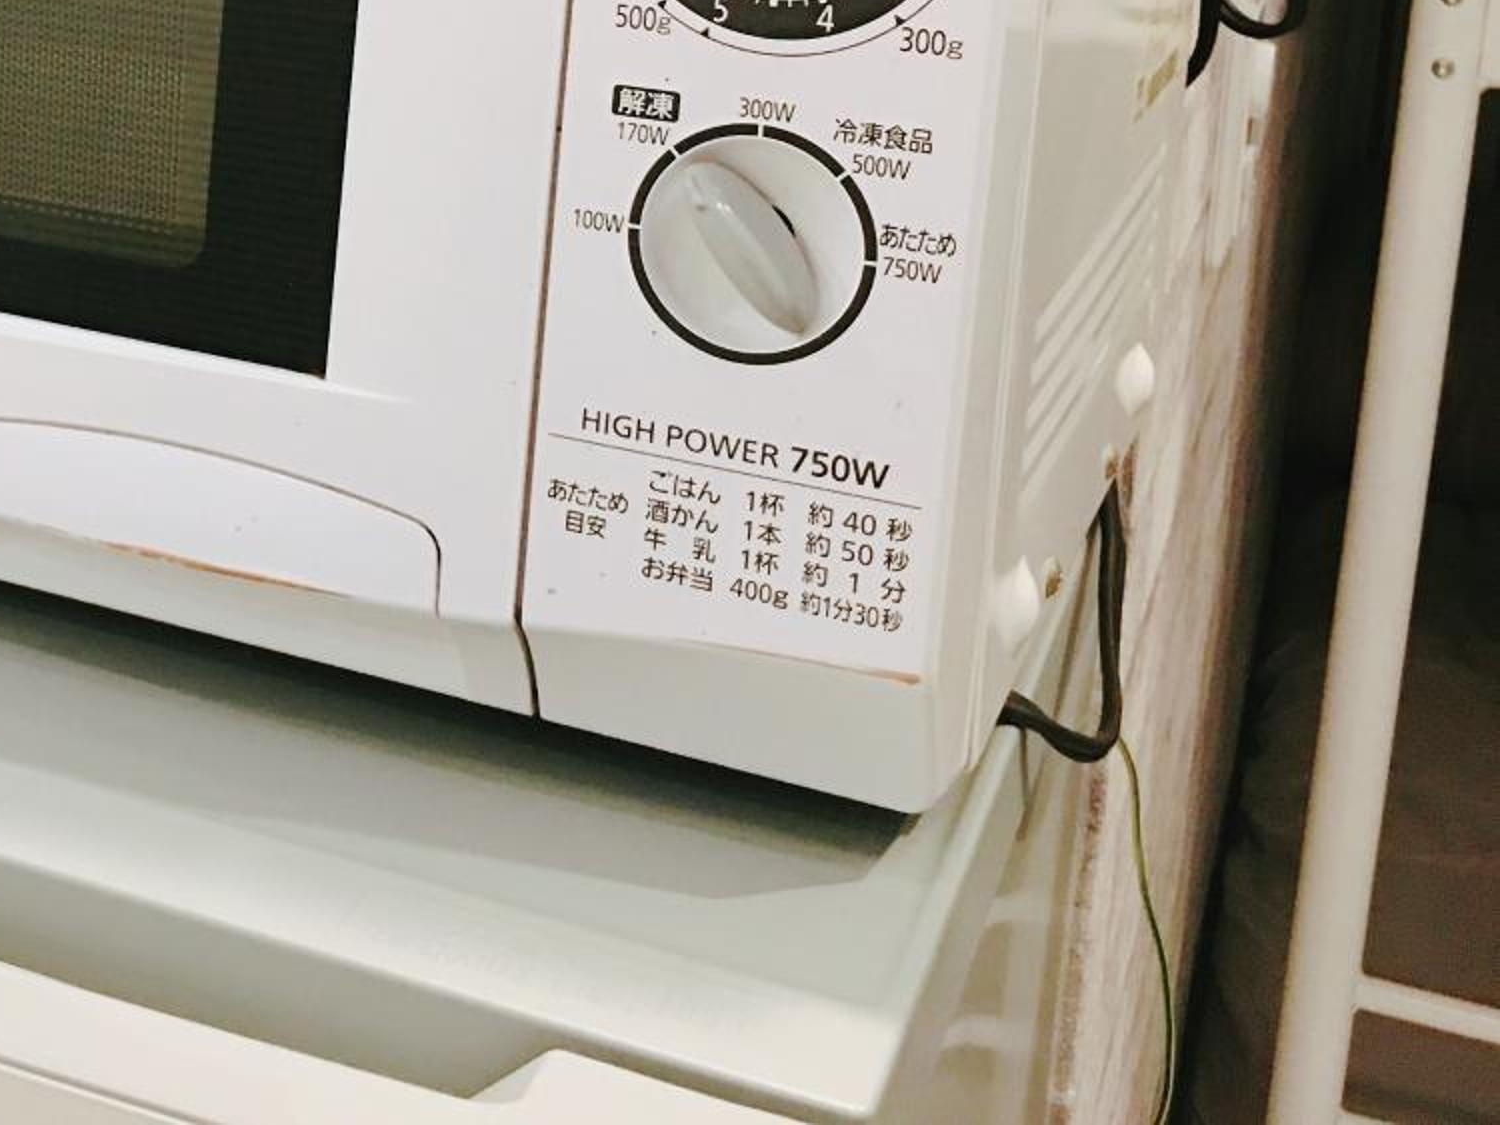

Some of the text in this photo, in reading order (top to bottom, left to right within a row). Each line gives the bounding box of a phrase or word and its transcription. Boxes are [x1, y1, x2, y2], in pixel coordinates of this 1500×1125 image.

[615, 4, 672, 35] 500g
[816, 3, 835, 31] 4
[899, 28, 963, 60] 300g
[617, 88, 675, 119] 解凍
[739, 99, 796, 121] 300W
[617, 123, 669, 145] 170W
[833, 117, 933, 153] 冷凍食品
[852, 155, 911, 180] 500W
[573, 209, 625, 232] 100W
[879, 224, 957, 257] あたため
[882, 257, 942, 284] 750W
[581, 408, 890, 489] HIGH POWER 750W
[547, 479, 629, 514] あたため
[649, 470, 913, 543] ごはん 1杯 約 40 秒
[565, 511, 607, 539] 目安
[645, 498, 909, 572] 酒かん 1本 約 50 秒
[643, 528, 667, 550] 牛
[741, 550, 779, 576] 1杯
[803, 561, 827, 587] 約
[849, 572, 860, 594] 1
[881, 578, 905, 603] 分
[642, 556, 713, 593] お弁当
[730, 578, 788, 611] 400g
